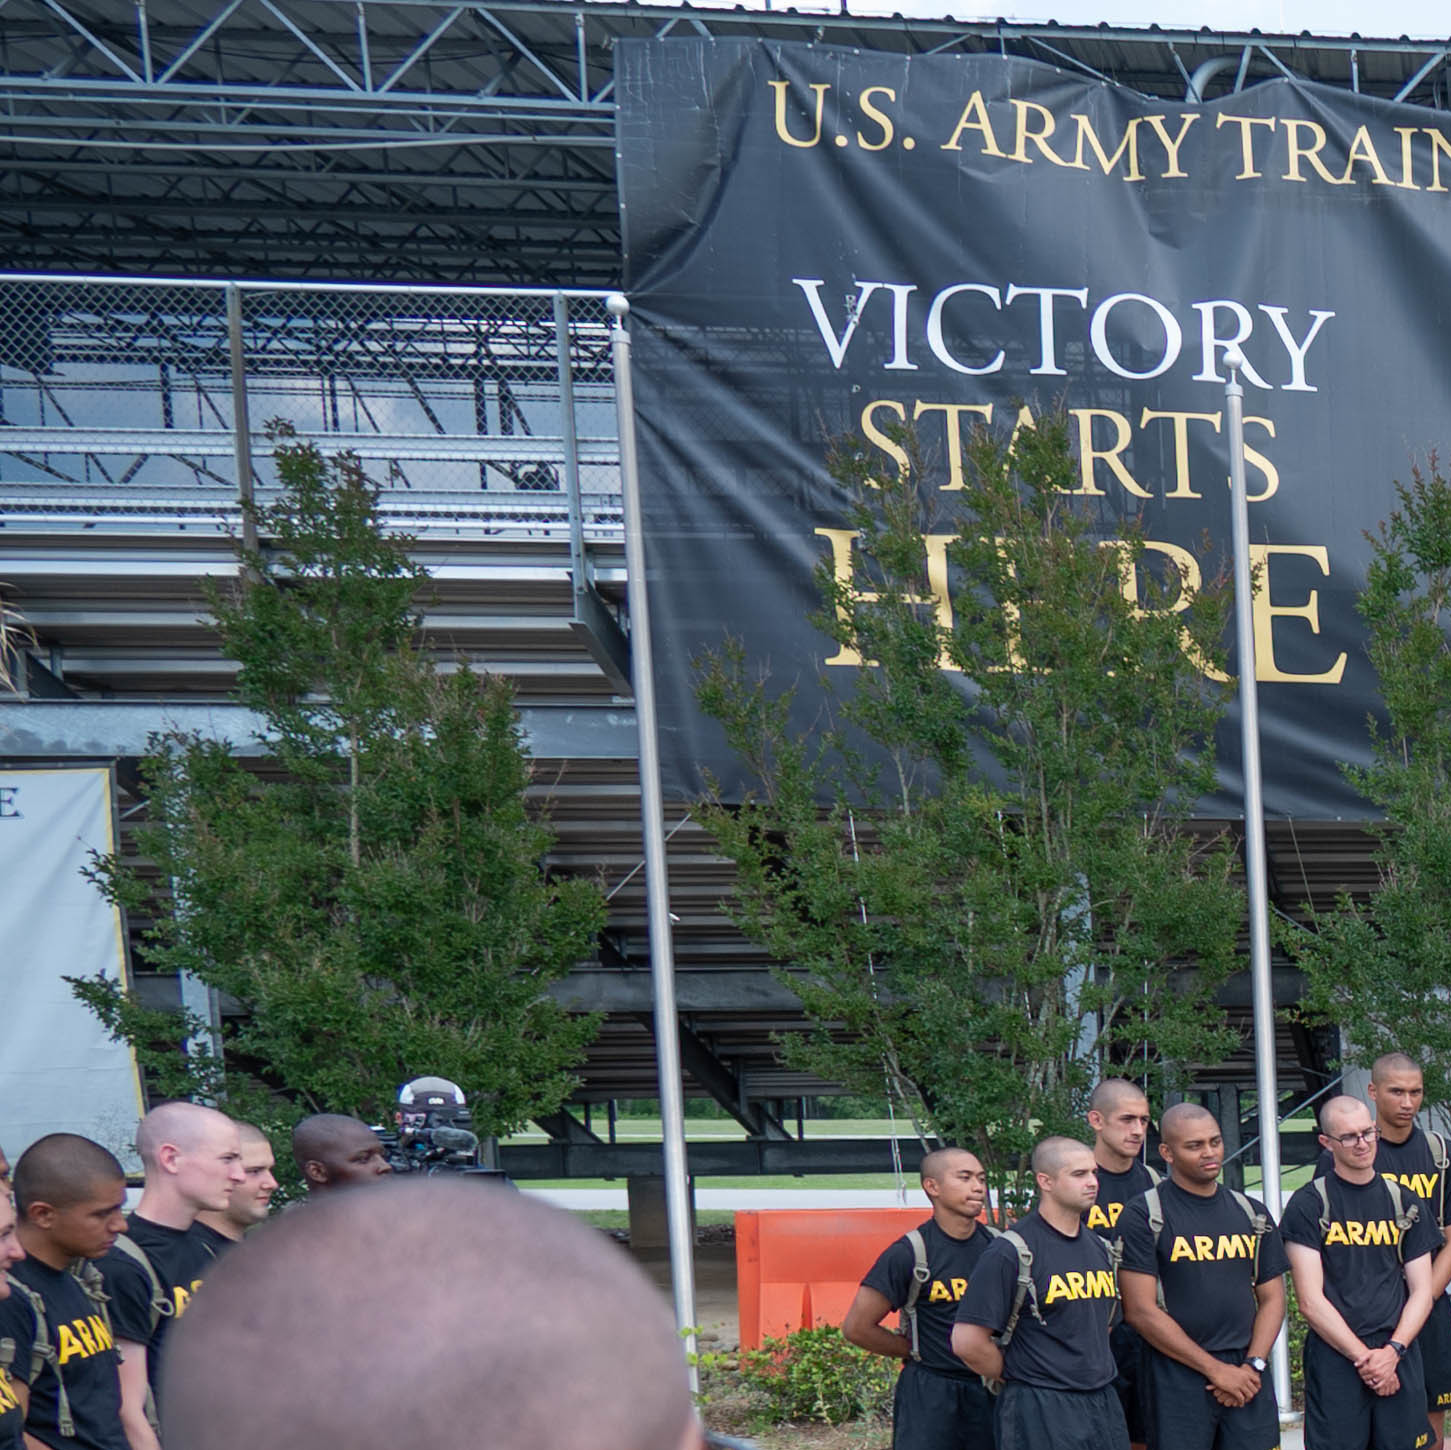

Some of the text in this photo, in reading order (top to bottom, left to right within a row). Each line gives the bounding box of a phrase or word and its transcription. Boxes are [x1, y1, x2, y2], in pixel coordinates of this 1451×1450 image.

[768, 80, 914, 151] U.S.
[941, 89, 1201, 182] ARMY
[792, 278, 1335, 392] VICTORY
[1325, 1221, 1400, 1246] ARMY
[1170, 1239, 1255, 1263] ARMY
[1045, 1271, 1114, 1305] ARMY
